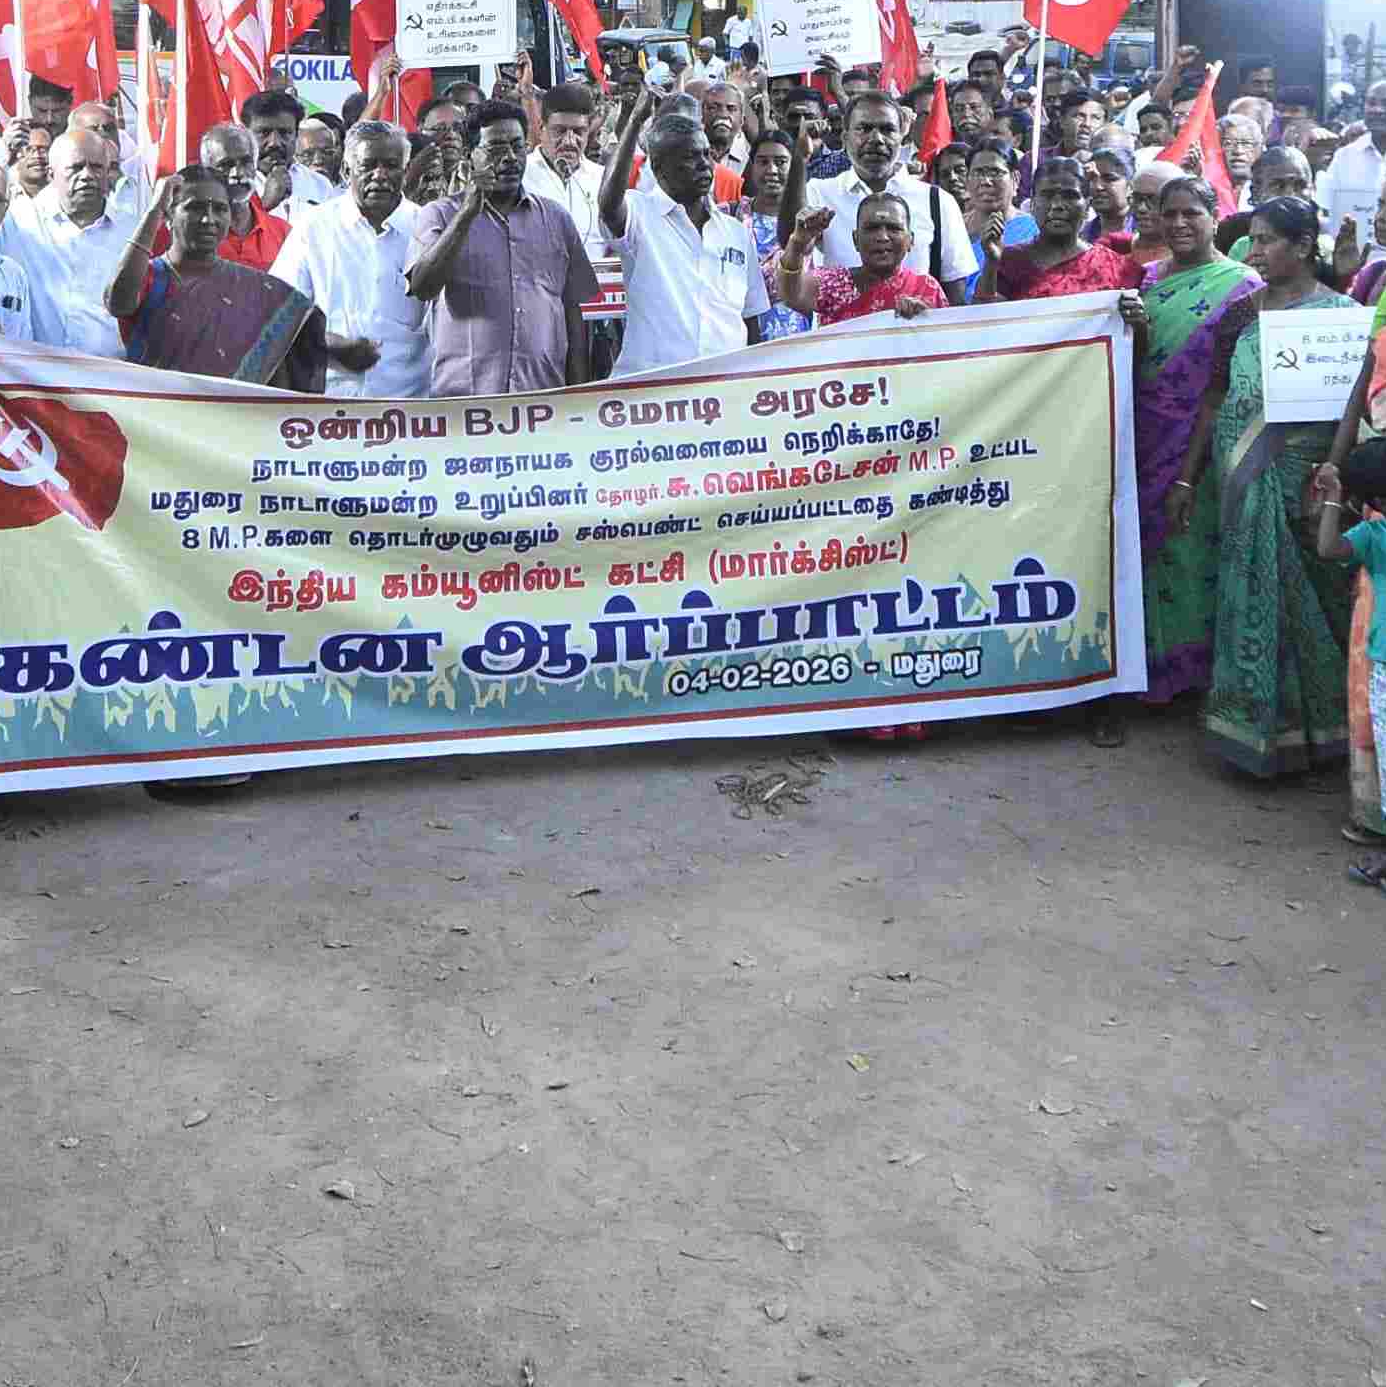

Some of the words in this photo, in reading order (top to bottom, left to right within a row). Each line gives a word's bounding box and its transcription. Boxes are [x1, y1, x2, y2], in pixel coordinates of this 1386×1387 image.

[252, 454, 428, 482] நாடாளுமன்ற
[445, 449, 573, 480] ஜனநாயக
[590, 432, 768, 471] குரல்வளையை
[783, 416, 942, 456] நெறிக்காதே!
[280, 409, 447, 449] ஒன்றிய
[464, 404, 554, 436] BJP
[598, 393, 722, 431] மோடி
[751, 375, 891, 420] அரசே!
[151, 490, 244, 522] மதுரை
[259, 489, 439, 519] நாடாளுமன்ற
[455, 482, 589, 521] உறுப்பினர்
[969, 435, 1038, 463] உட்பட
[181, 526, 201, 551] 8
[575, 514, 702, 543] சஸ்பெண்ட்
[717, 497, 894, 529] செய்யப்பட்டதை
[908, 478, 1011, 514] கண்டித்து
[228, 568, 357, 612] இந்திய
[381, 562, 586, 611] கம்யூனிஸ்ட்
[607, 552, 684, 587] கட்சி
[708, 529, 909, 585] (மார்க்சிஸ்ட்)
[462, 556, 1078, 682] ஆர்ப்பாட்டம்
[668, 656, 851, 697] 04-02-2026
[891, 644, 982, 686] மதுரை
